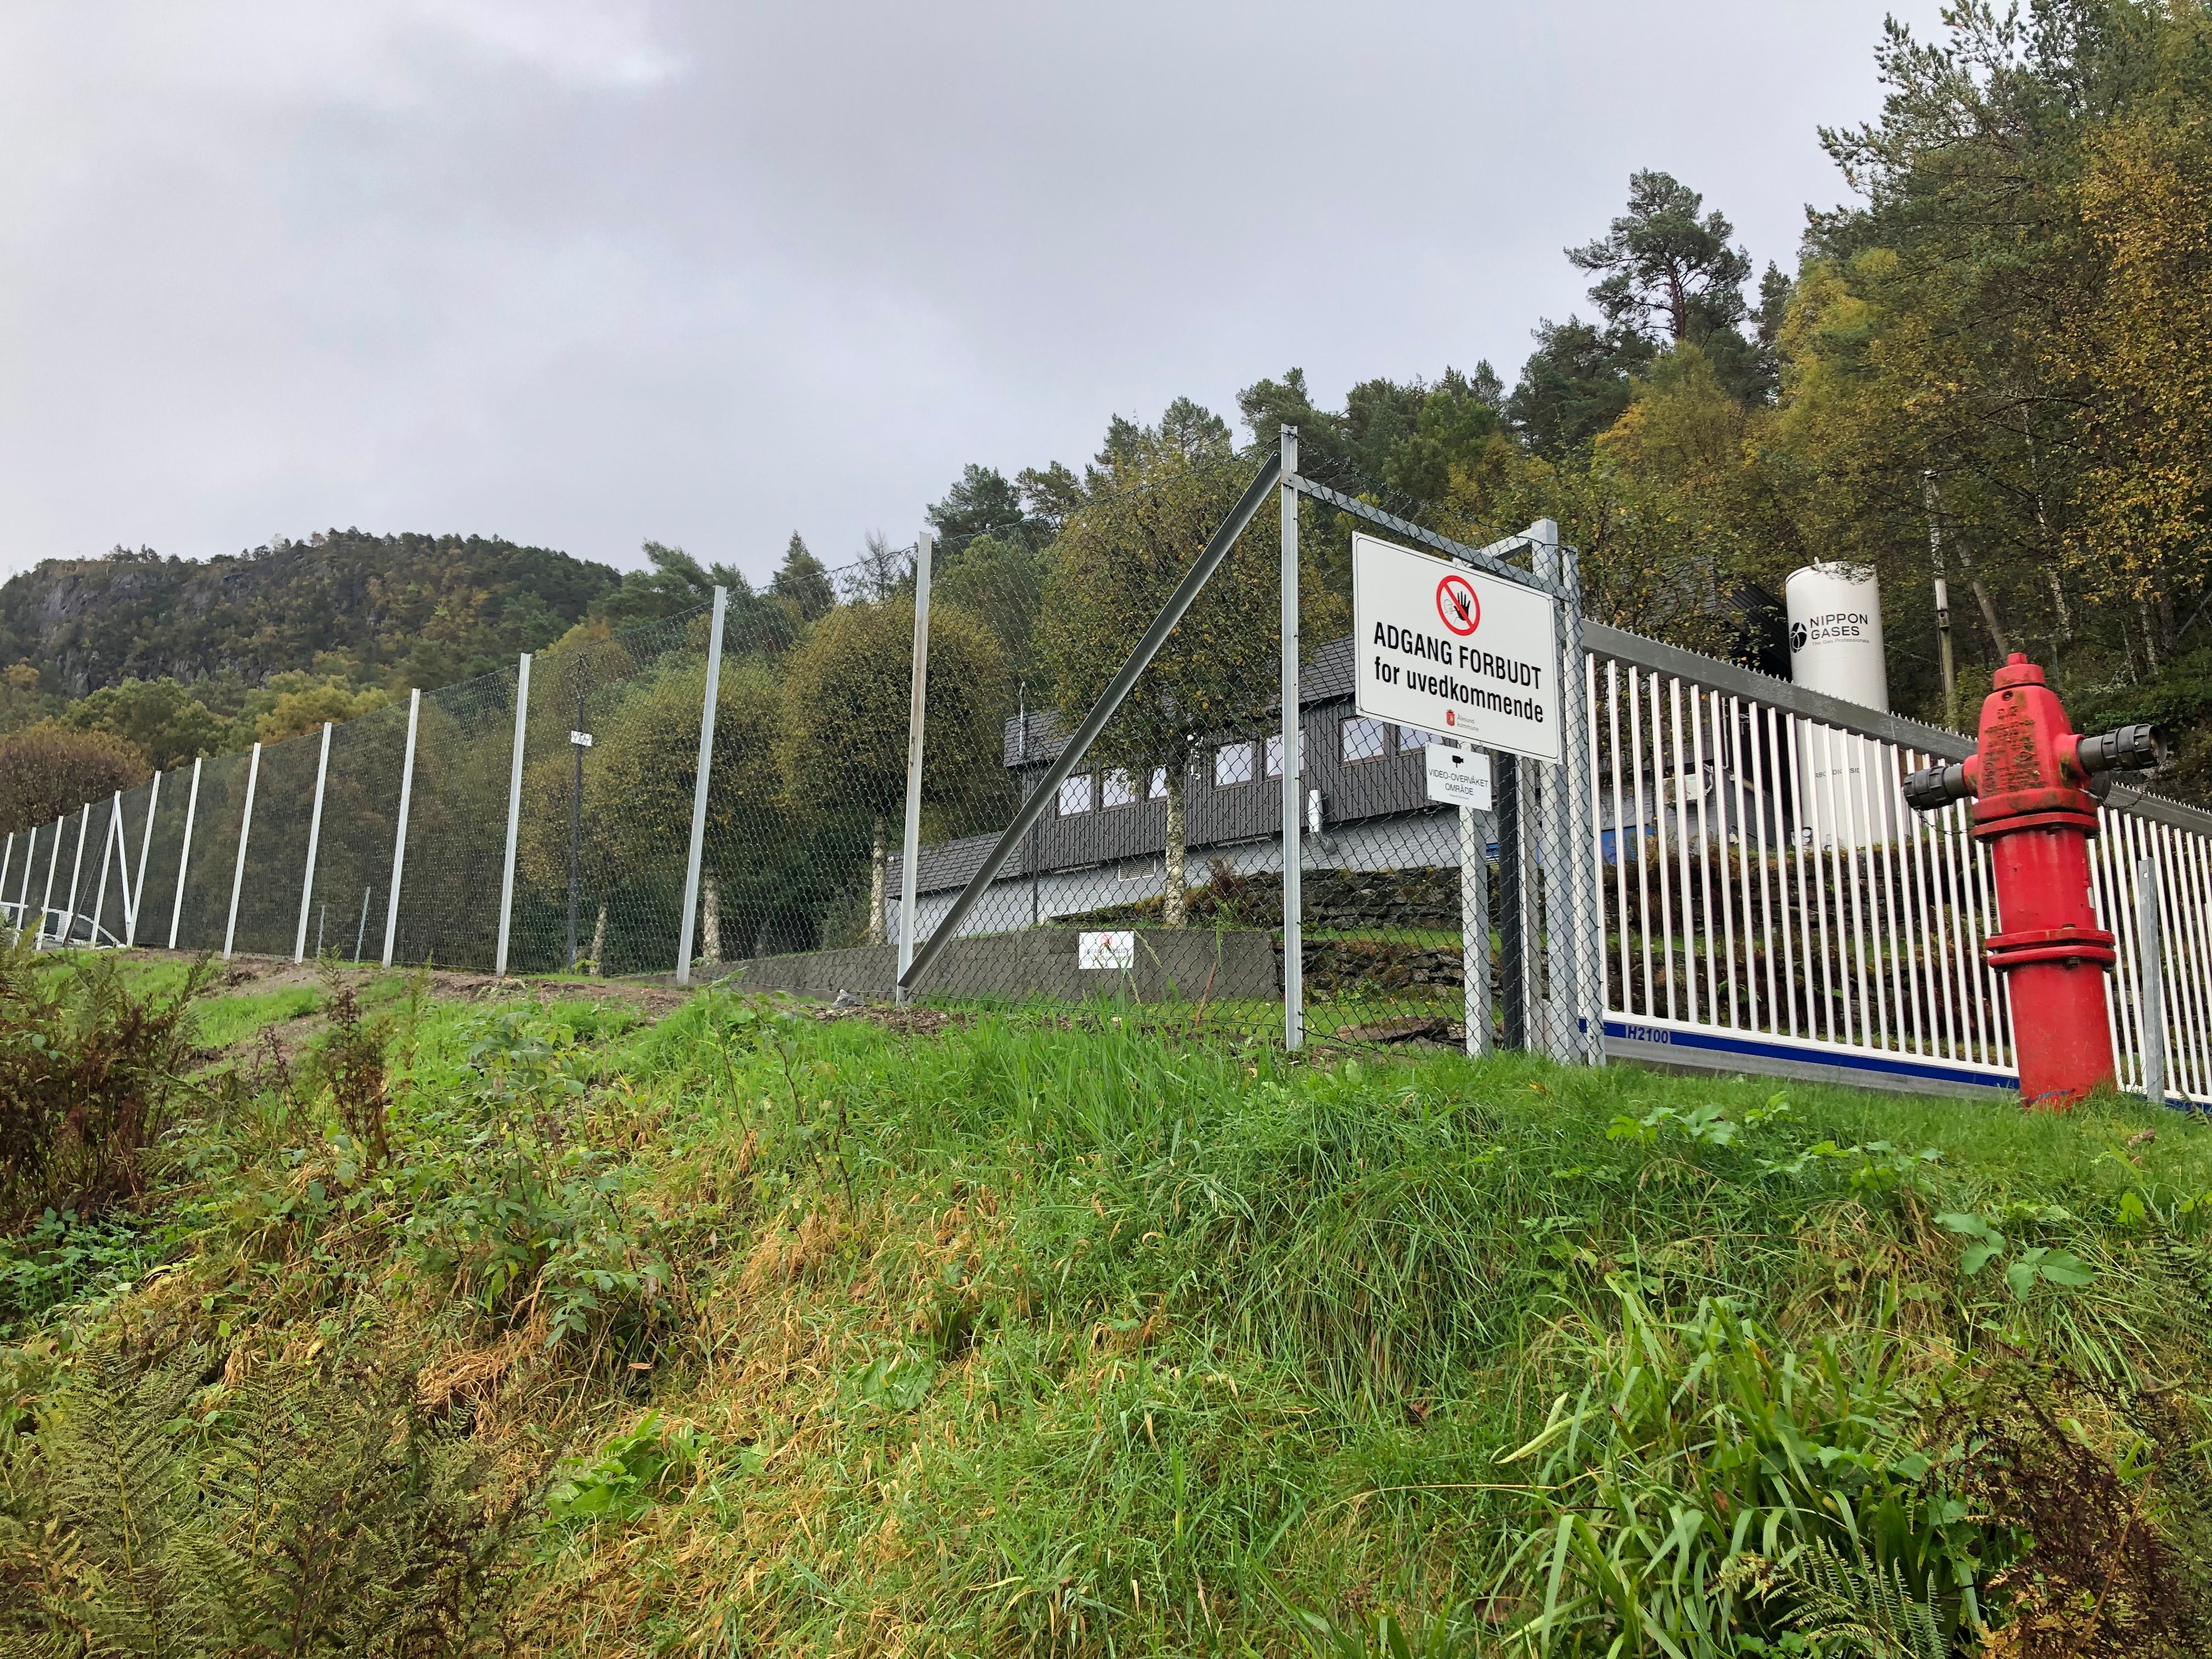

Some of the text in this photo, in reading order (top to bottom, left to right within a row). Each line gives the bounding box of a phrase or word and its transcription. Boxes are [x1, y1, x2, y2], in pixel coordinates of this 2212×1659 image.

[1810, 613, 1868, 628] NIPPON
[1812, 626, 1859, 640] GASES
[1374, 622, 1541, 689] ADGANG FORBUDT
[1375, 656, 1543, 723] for uvedkommende
[1428, 768, 1488, 787] VIDEO-OVERVÅKET
[1444, 783, 1474, 795] OMRÅDE
[1627, 1025, 1668, 1044] H2100
